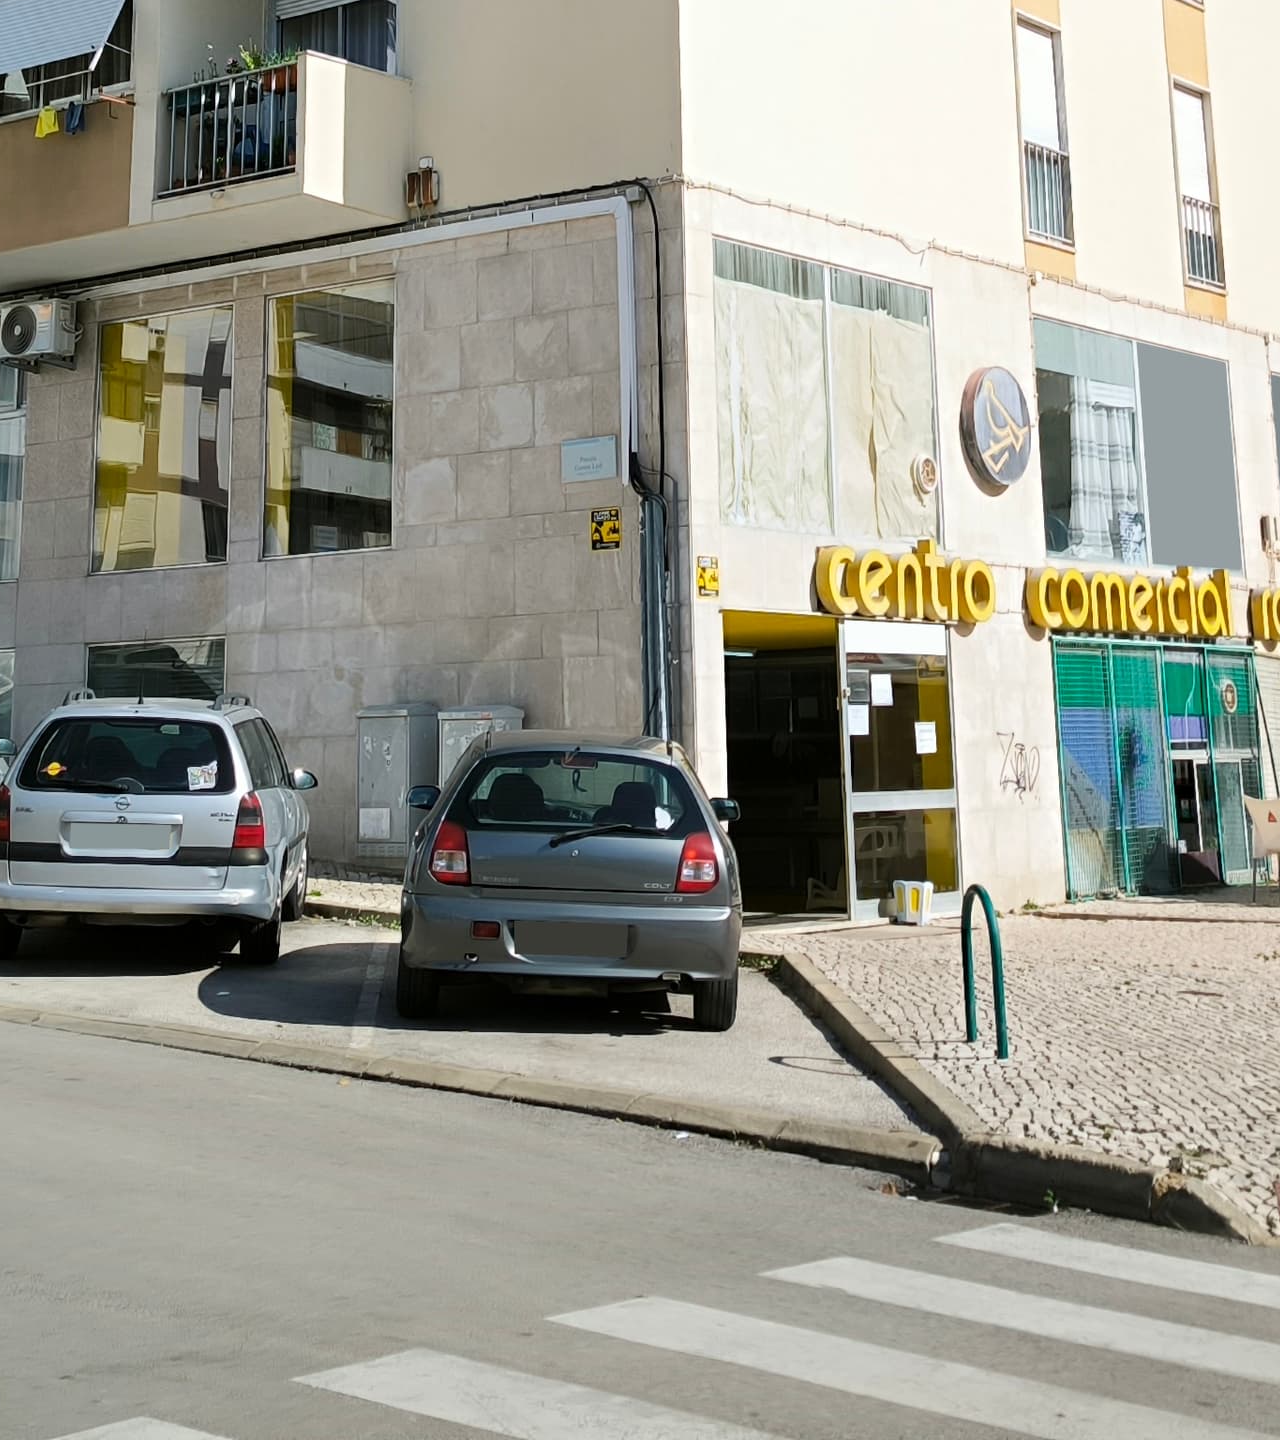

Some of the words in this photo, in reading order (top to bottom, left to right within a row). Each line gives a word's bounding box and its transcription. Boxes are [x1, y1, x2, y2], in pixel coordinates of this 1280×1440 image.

[827, 537, 996, 623] centro
[1037, 556, 1233, 637] comercial
[643, 882, 672, 890] COLT
